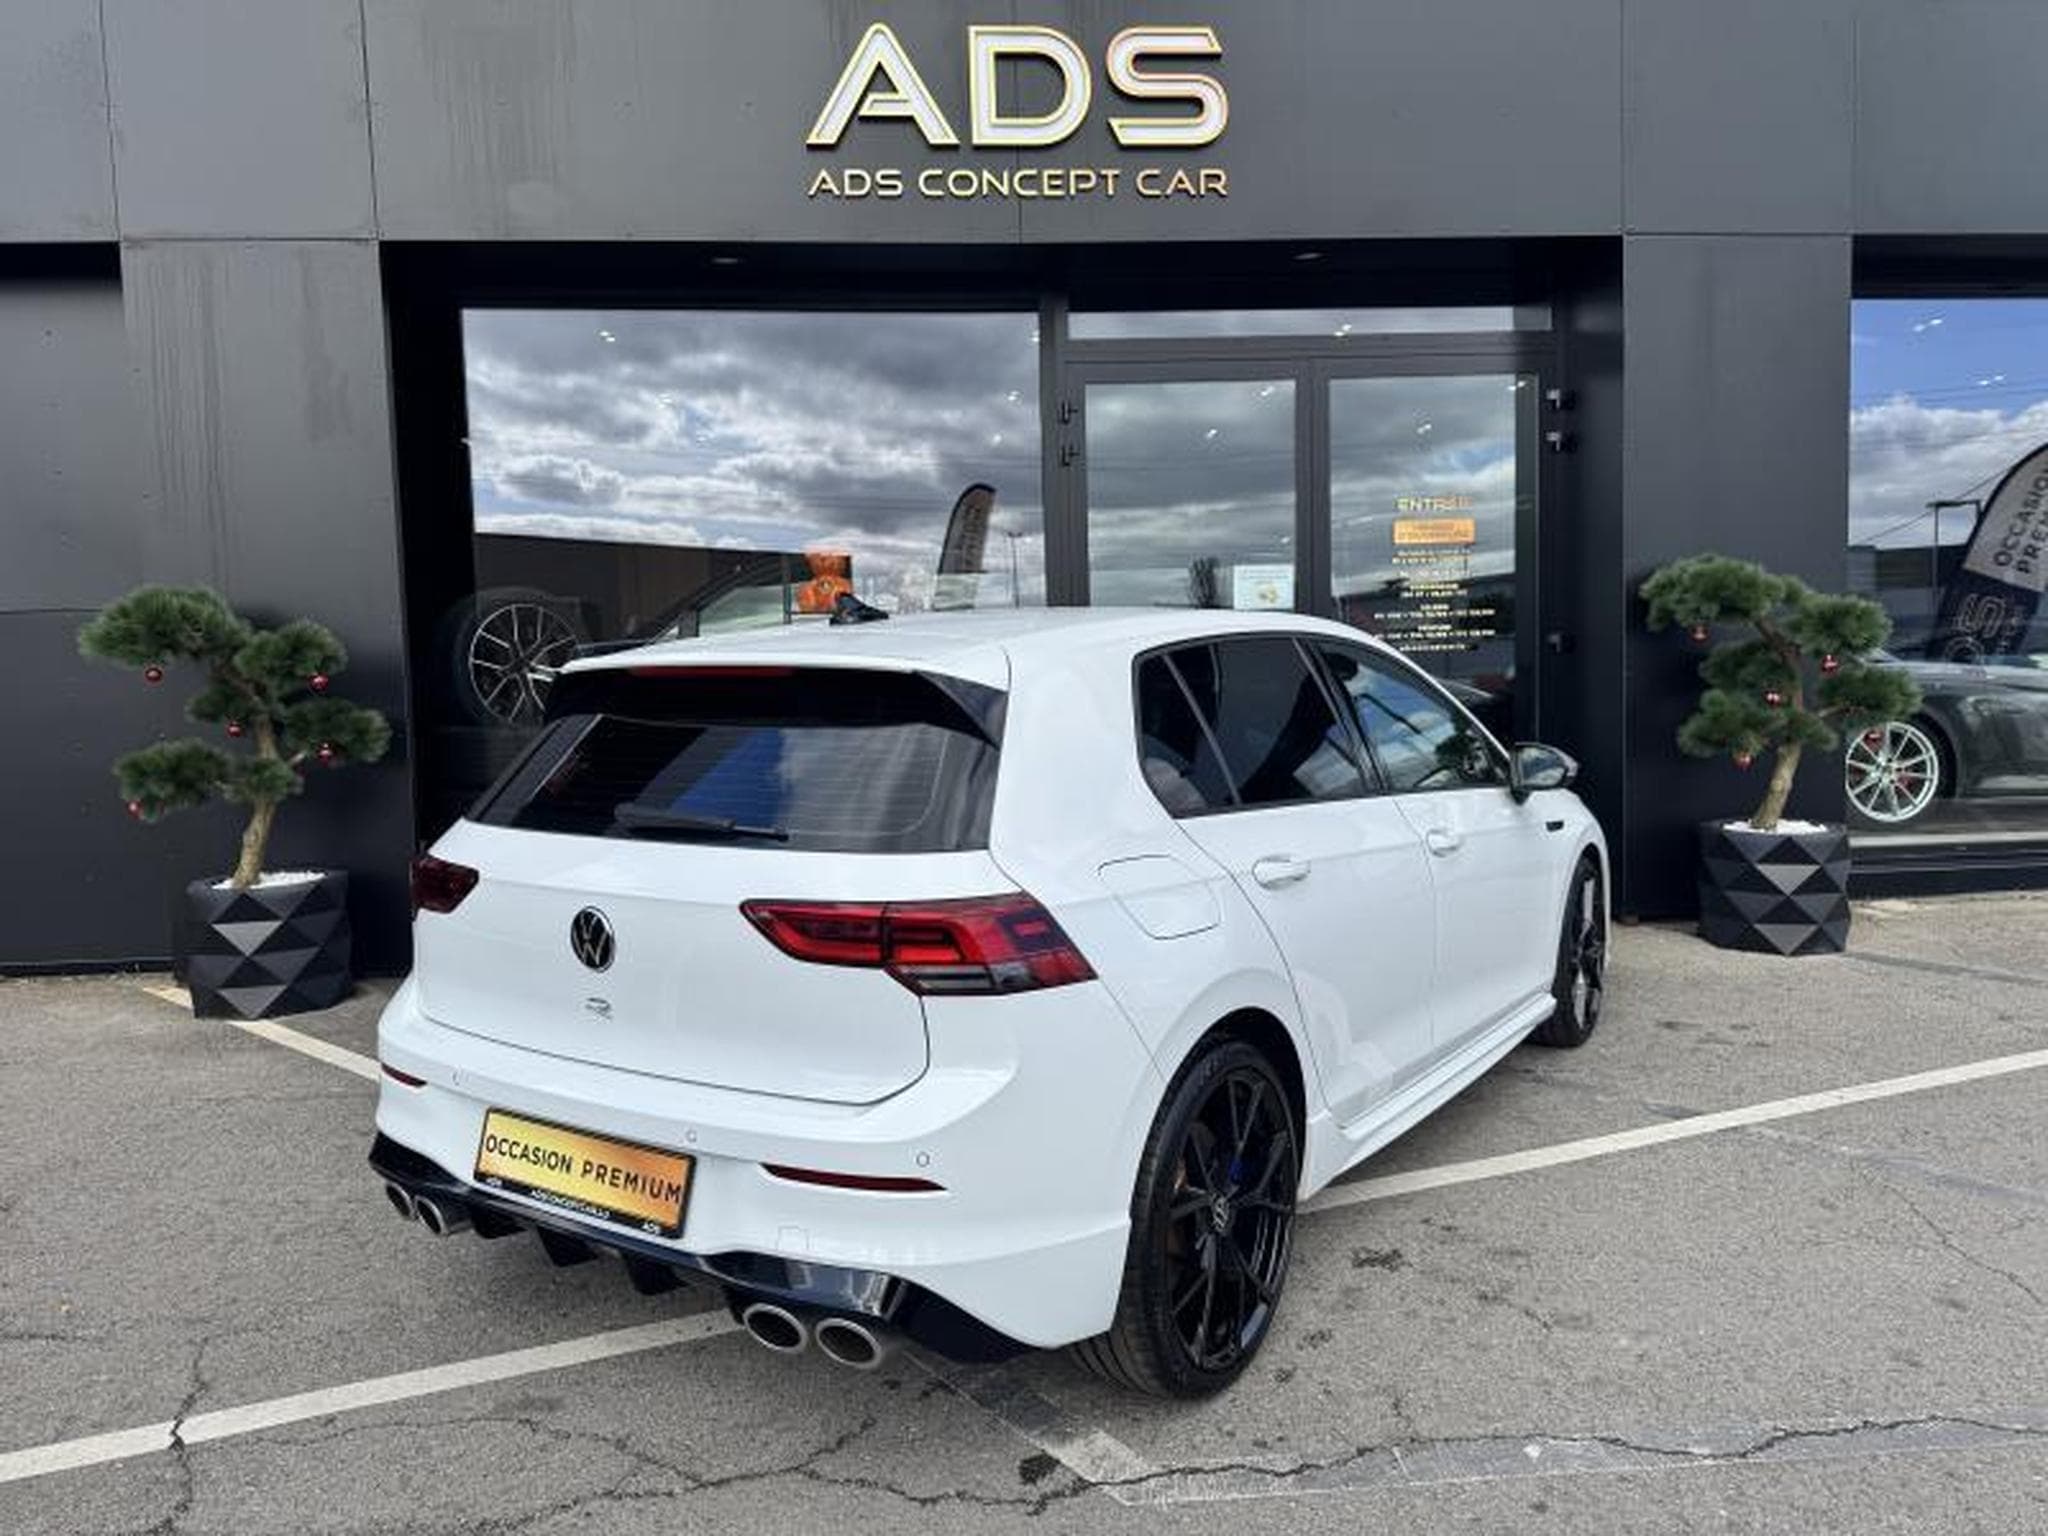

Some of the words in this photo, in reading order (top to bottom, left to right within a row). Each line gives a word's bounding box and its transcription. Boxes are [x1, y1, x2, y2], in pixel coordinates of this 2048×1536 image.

[806, 22, 1229, 146] ADS
[808, 169, 903, 197] ADS
[918, 168, 1120, 198] CONCEPT
[1135, 169, 1229, 197] CAR
[485, 1134, 574, 1174] OCCASION
[580, 1160, 683, 1203] PREMIUM
